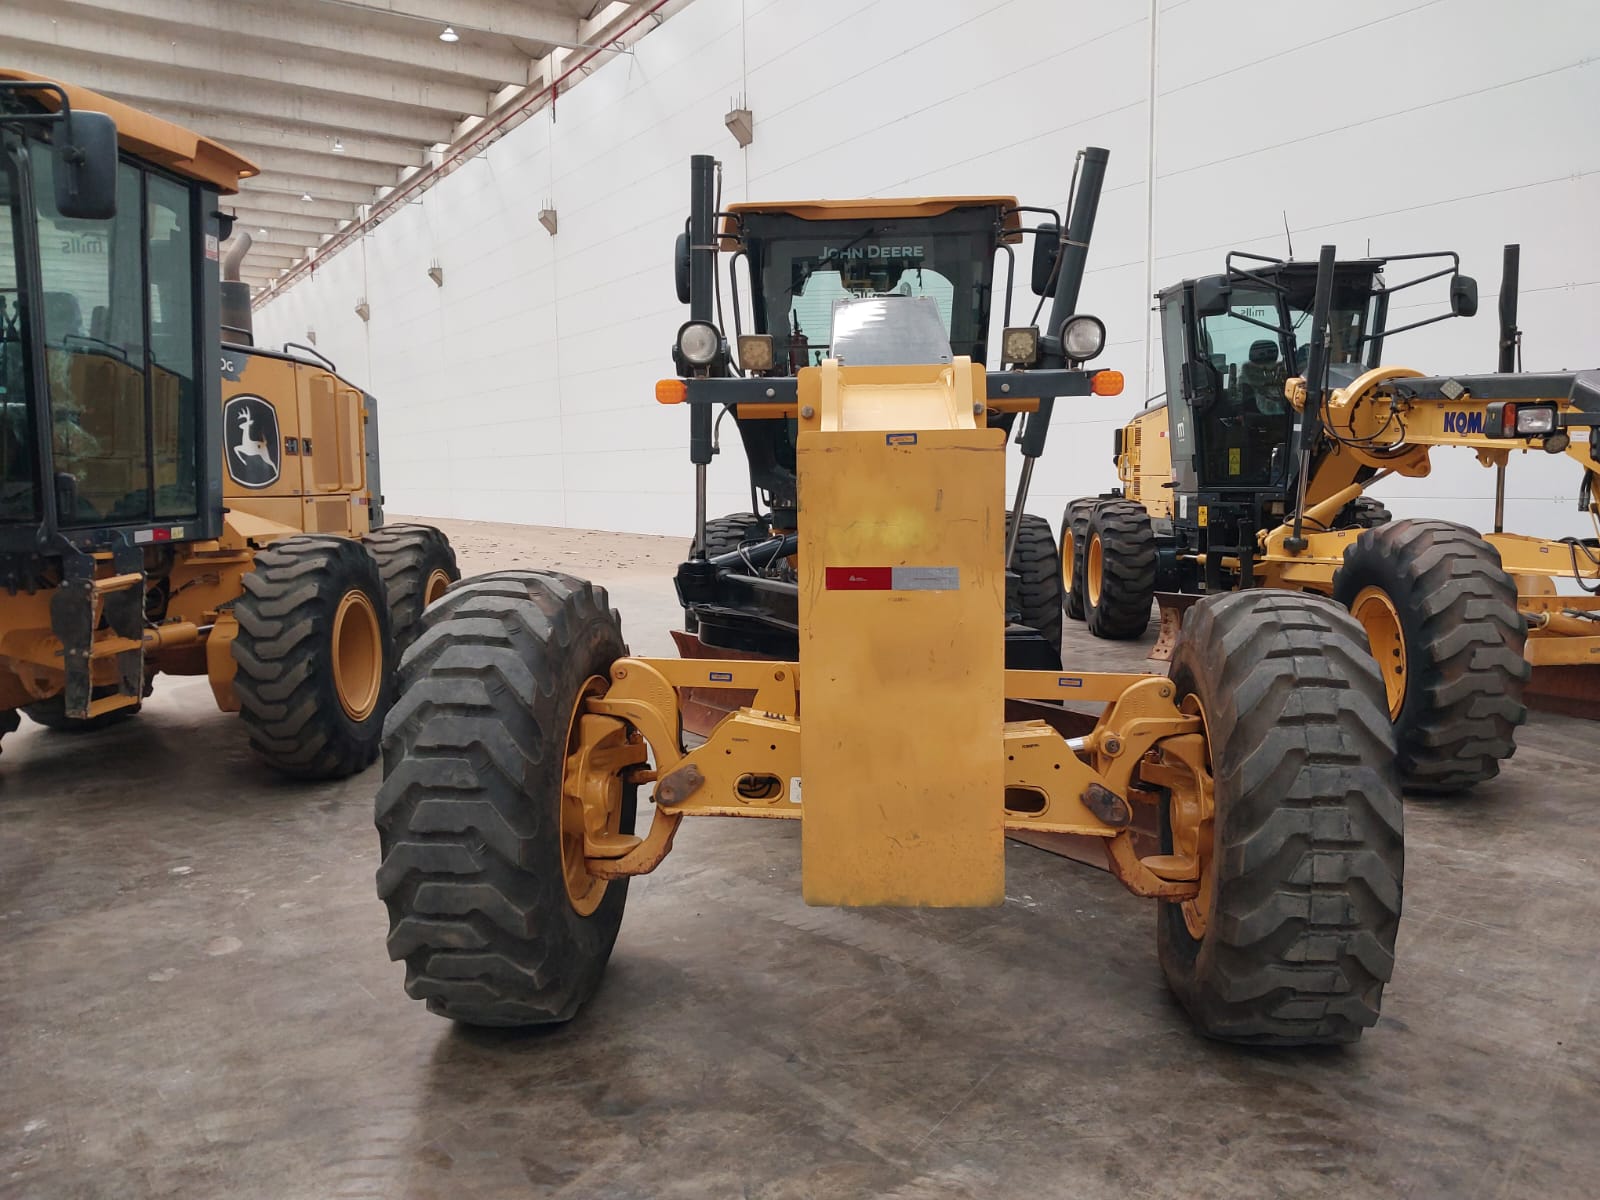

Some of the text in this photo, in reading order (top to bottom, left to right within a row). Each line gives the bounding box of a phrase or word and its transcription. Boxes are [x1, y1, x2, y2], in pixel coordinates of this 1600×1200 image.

[818, 245, 923, 259] JOHN DEERE
[1443, 412, 1486, 433] KOM
